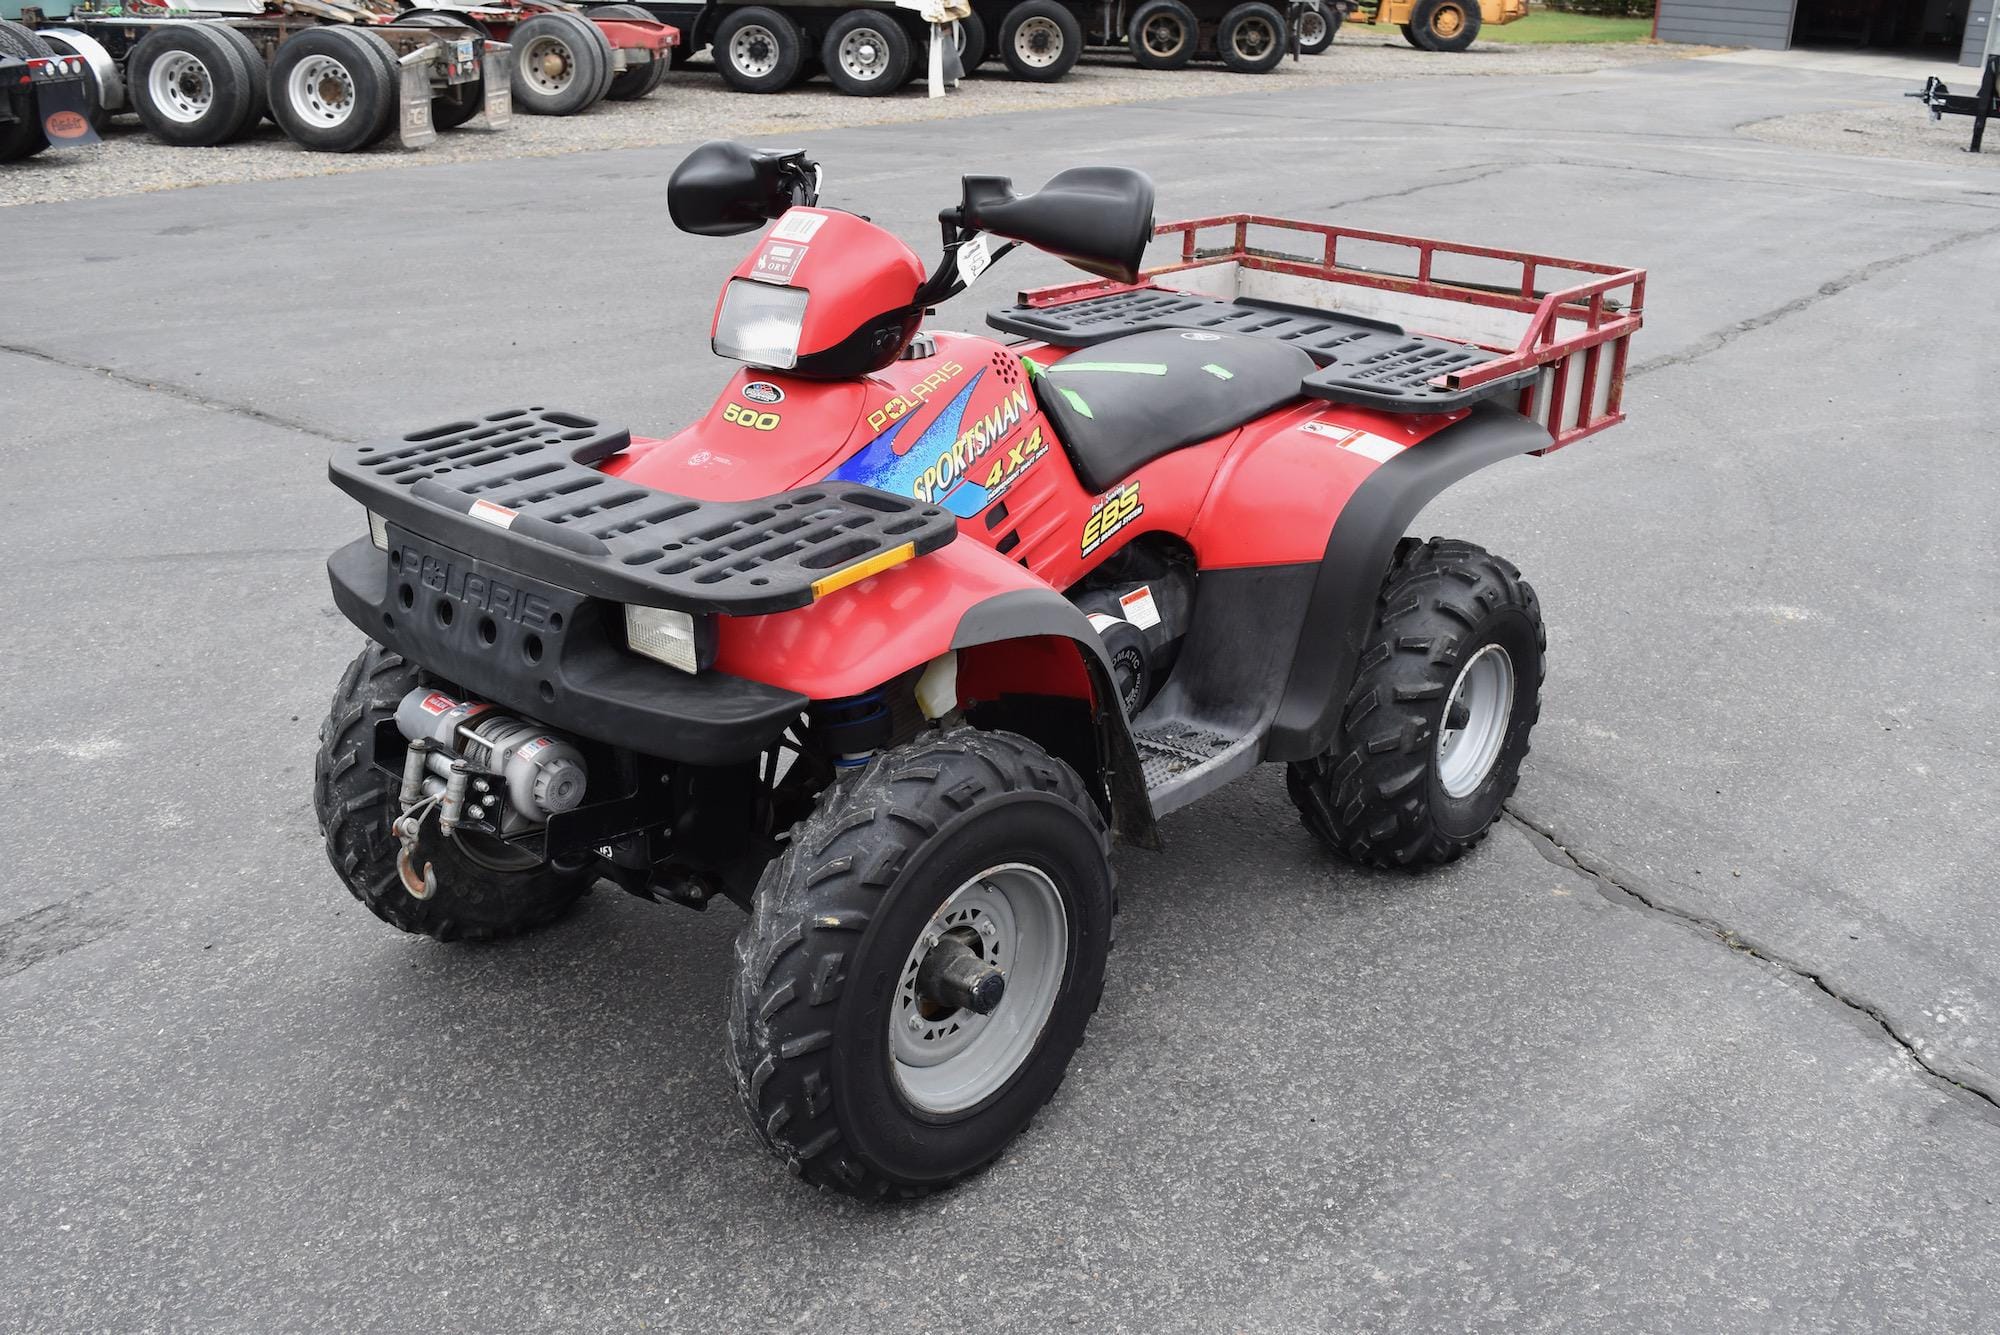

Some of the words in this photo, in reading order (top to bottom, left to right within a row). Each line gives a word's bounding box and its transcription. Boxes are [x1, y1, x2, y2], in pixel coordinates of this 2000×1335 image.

[767, 262, 788, 272] ORV
[722, 401, 781, 431] 500
[867, 360, 964, 433] POLARIS
[913, 382, 1030, 505] SPORTSMAN
[1081, 480, 1140, 550] EBS
[399, 544, 551, 633] POLARIS
